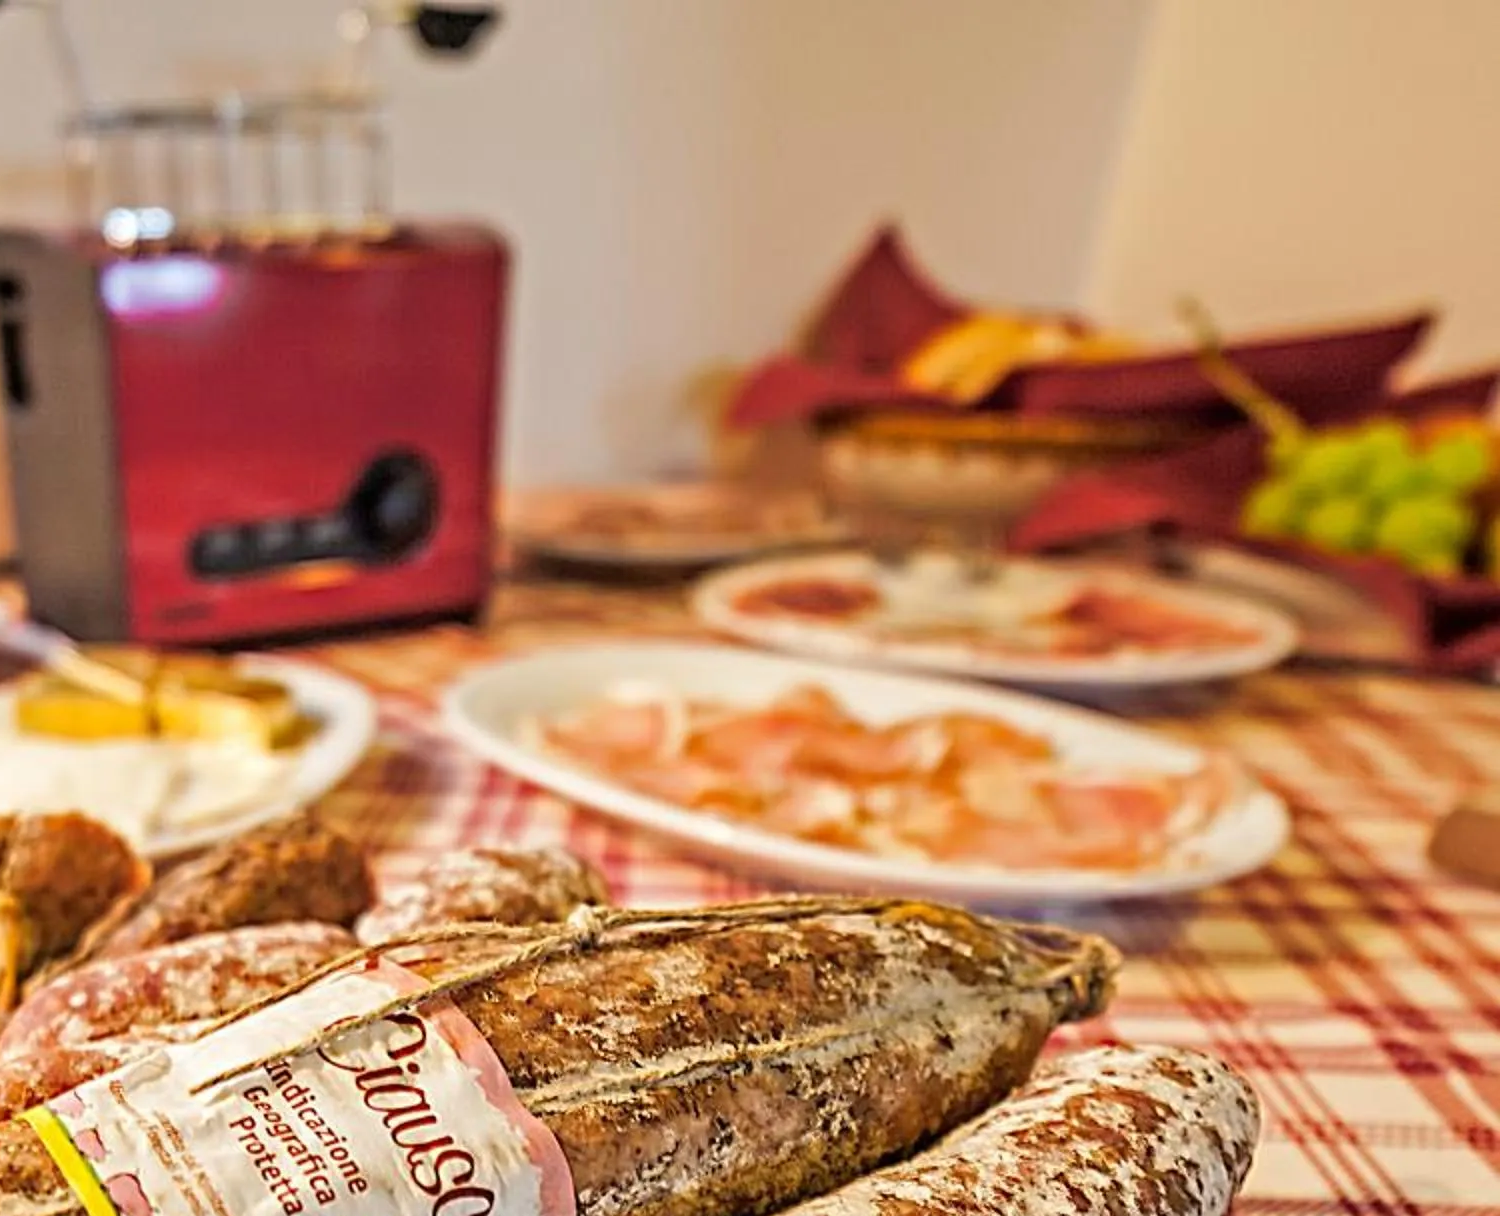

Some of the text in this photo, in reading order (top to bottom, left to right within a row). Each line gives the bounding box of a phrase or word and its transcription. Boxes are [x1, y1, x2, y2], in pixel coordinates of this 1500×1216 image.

[228, 1115, 304, 1216] Protetta
[243, 1085, 336, 1206] Geografica
[263, 1060, 369, 1195] Indicazione
